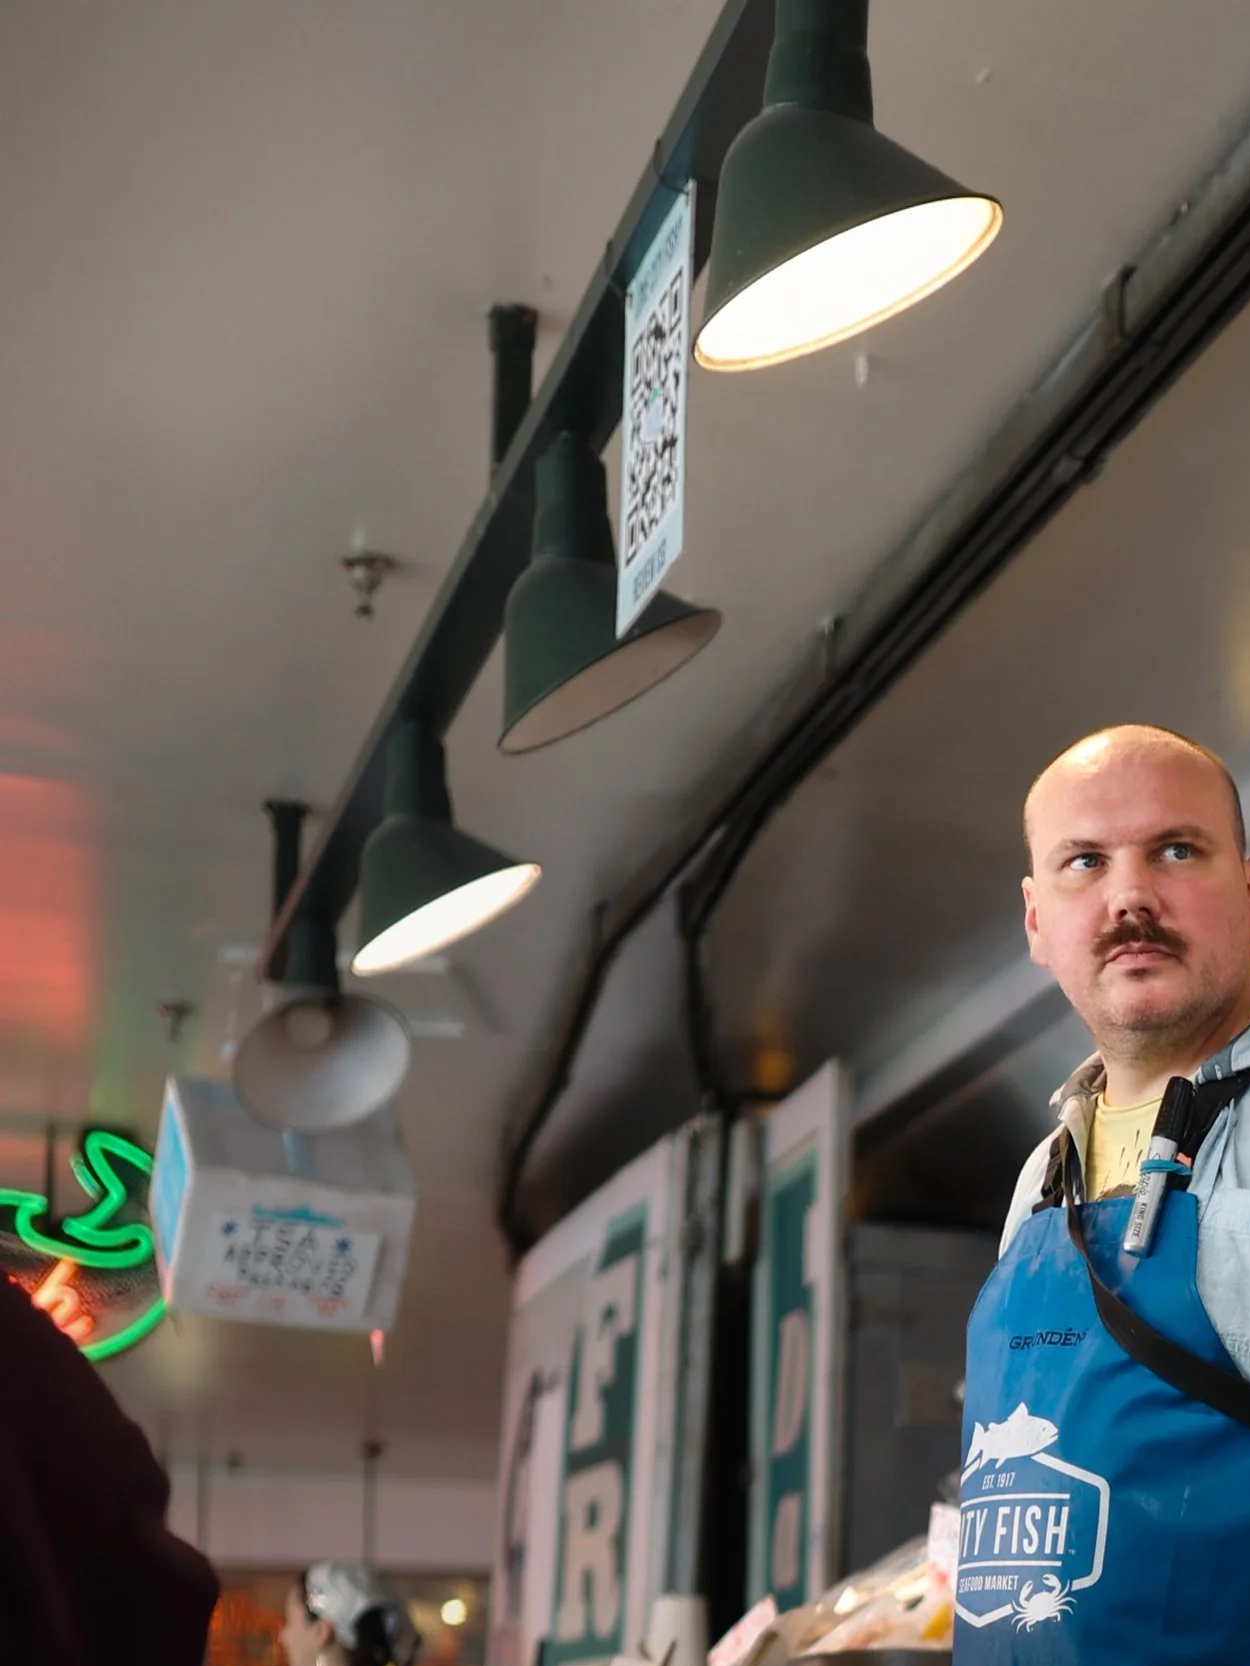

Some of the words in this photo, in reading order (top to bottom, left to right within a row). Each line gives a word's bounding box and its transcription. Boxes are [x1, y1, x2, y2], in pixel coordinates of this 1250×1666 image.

[1131, 1222, 1143, 1239] SIZE
[982, 1474, 995, 1490] EST.
[996, 1471, 1016, 1489] 1917
[959, 1508, 989, 1558] ITY
[993, 1504, 1070, 1555] FISH
[959, 1576, 983, 1593] SEAFOOD
[983, 1574, 1019, 1591] MARKET
